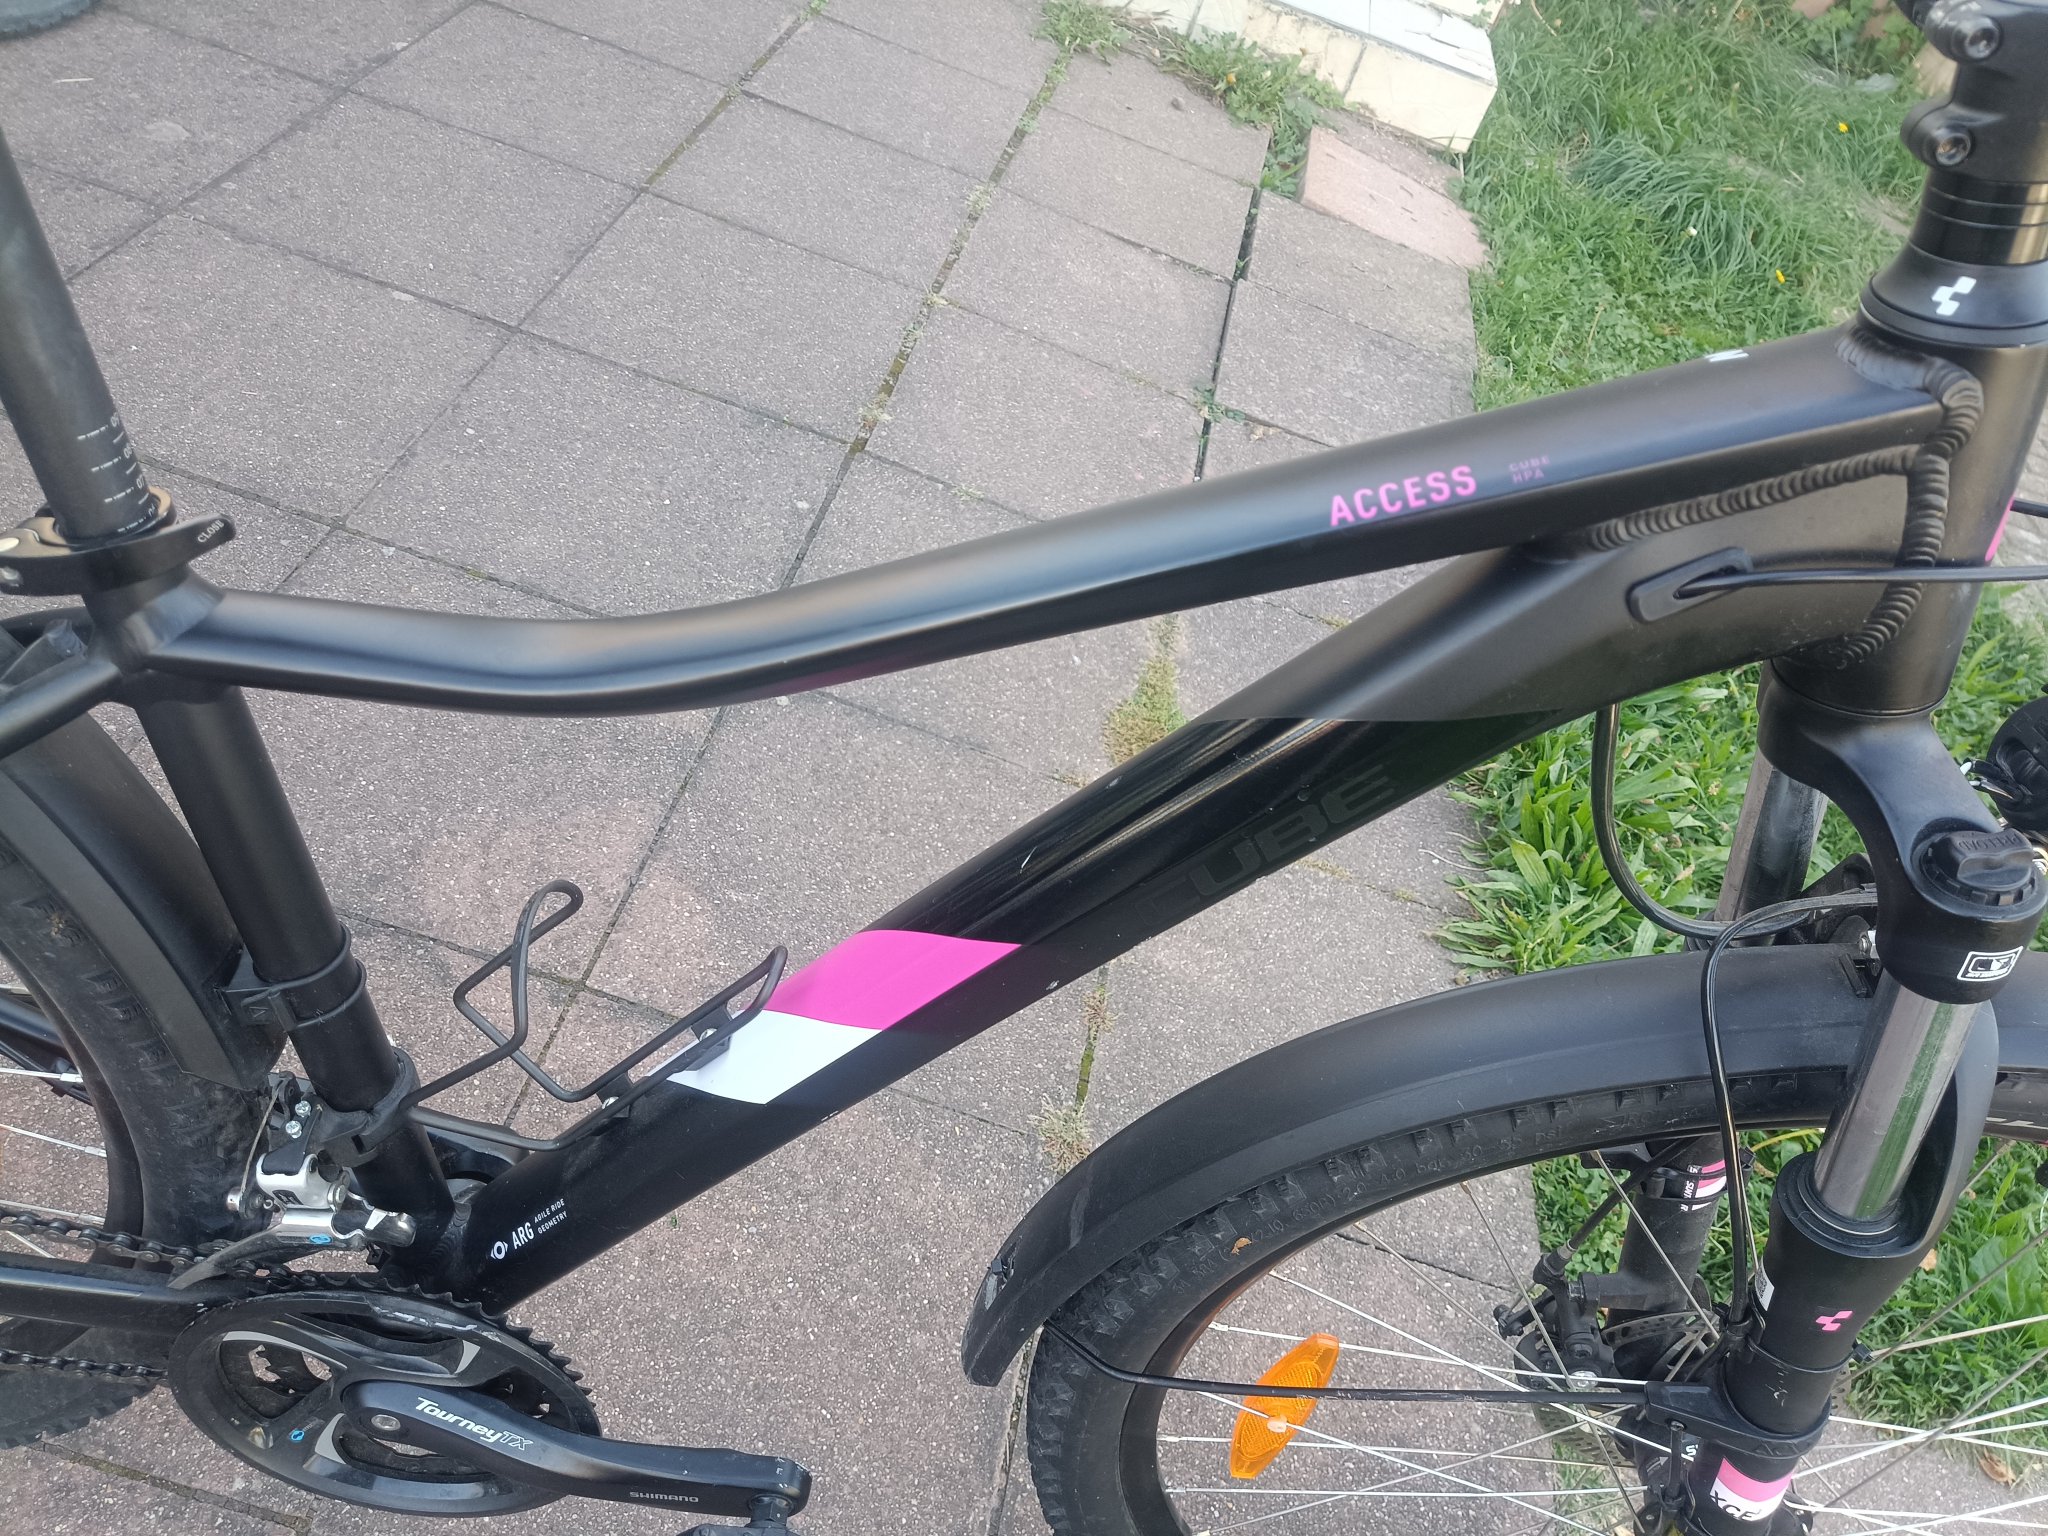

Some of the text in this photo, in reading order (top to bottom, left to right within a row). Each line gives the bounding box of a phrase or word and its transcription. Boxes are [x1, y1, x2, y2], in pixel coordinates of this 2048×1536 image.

[1511, 468, 1546, 484] HPA
[1330, 465, 1477, 526] ACCESS
[512, 1198, 565, 1250] ARG AGILE RIDE
[537, 1210, 567, 1234] GEOMETRY
[629, 1491, 699, 1503] SHIMANO
